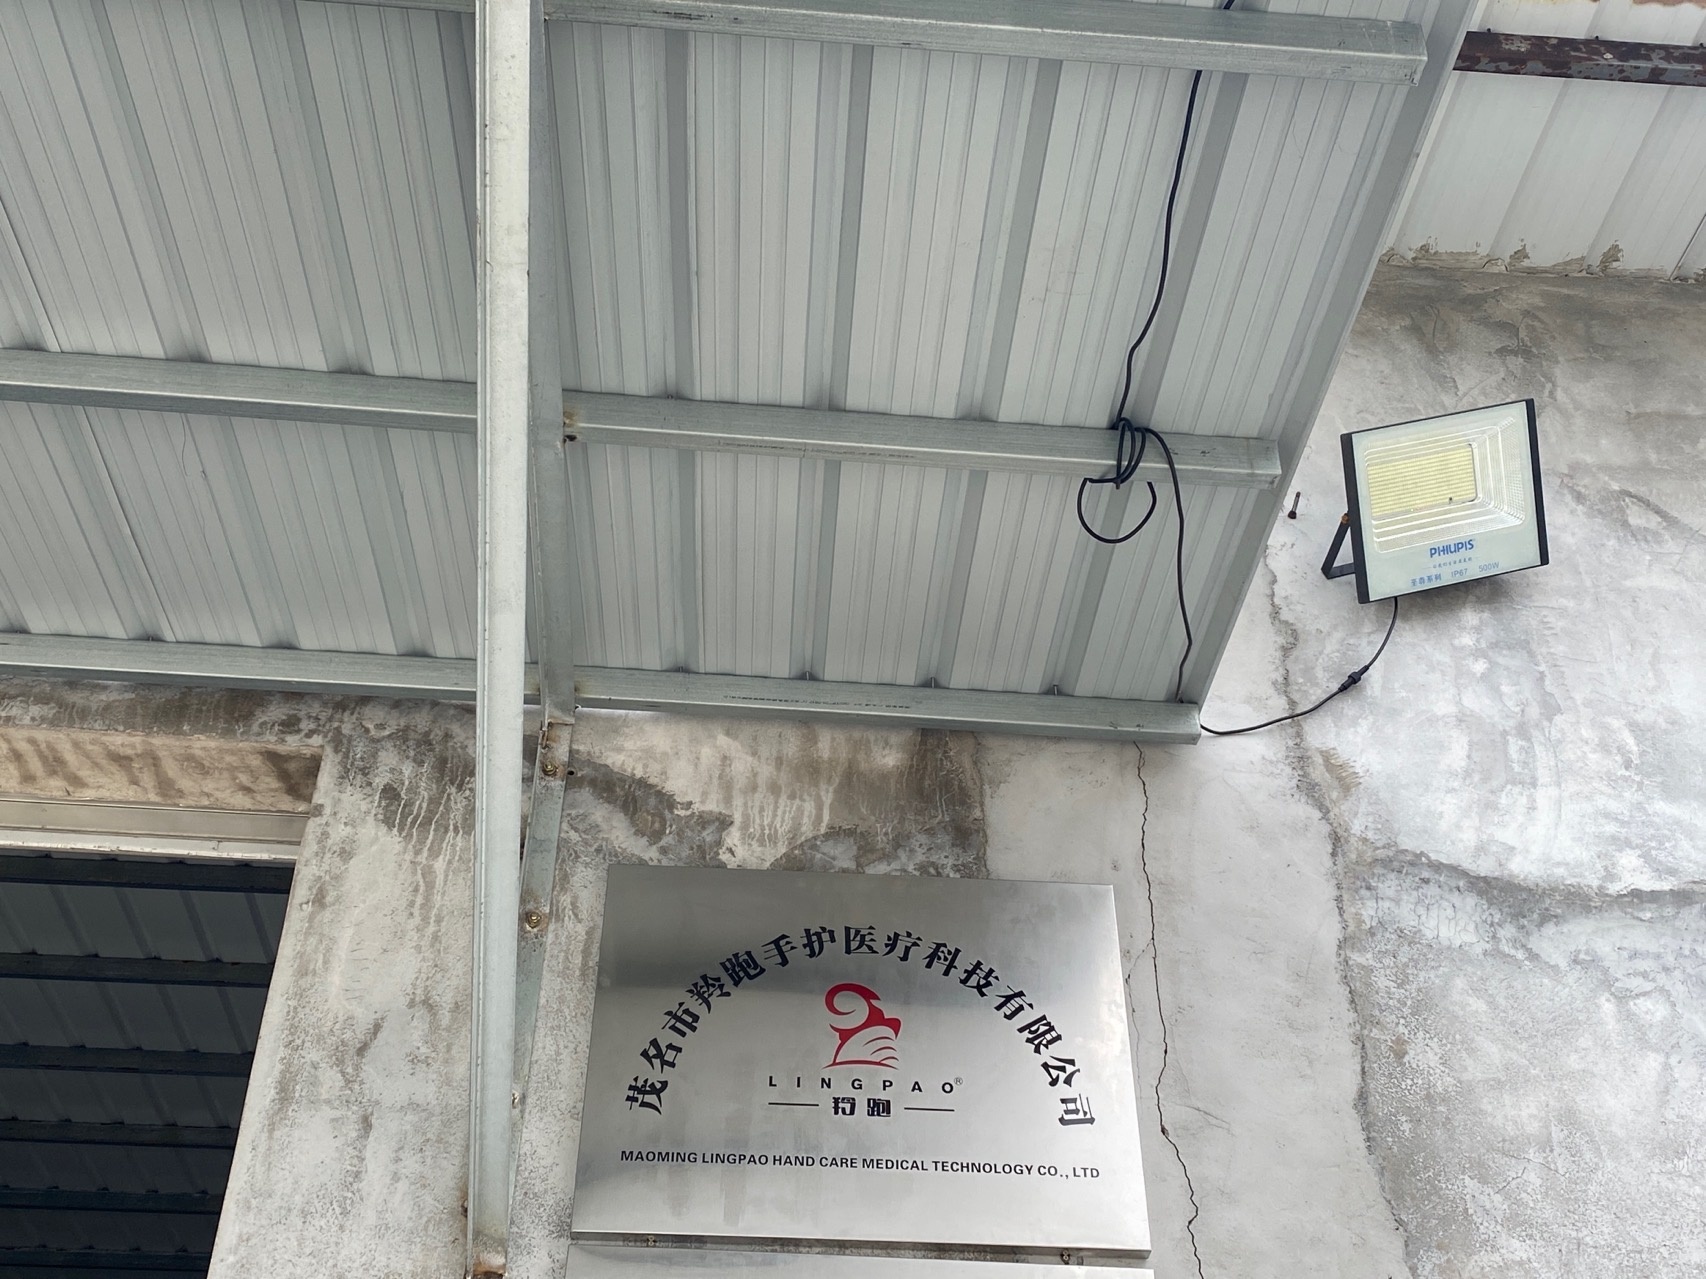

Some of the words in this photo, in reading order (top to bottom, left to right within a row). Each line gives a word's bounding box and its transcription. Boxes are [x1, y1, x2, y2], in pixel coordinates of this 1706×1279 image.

[1451, 568, 1468, 578] IP67
[1478, 562, 1500, 573] 500W
[625, 925, 1096, 1128] 茂名市羚跑手护医疗科技有限公司
[620, 1150, 698, 1163] MAOMING
[701, 1152, 769, 1166] LINGPAO
[772, 1154, 815, 1167] HAND
[819, 1156, 858, 1169] CARE
[862, 1158, 928, 1171] MEDICAL
[932, 1160, 1034, 1175] TECHNOLOGY
[1073, 1167, 1100, 1178] LTD
